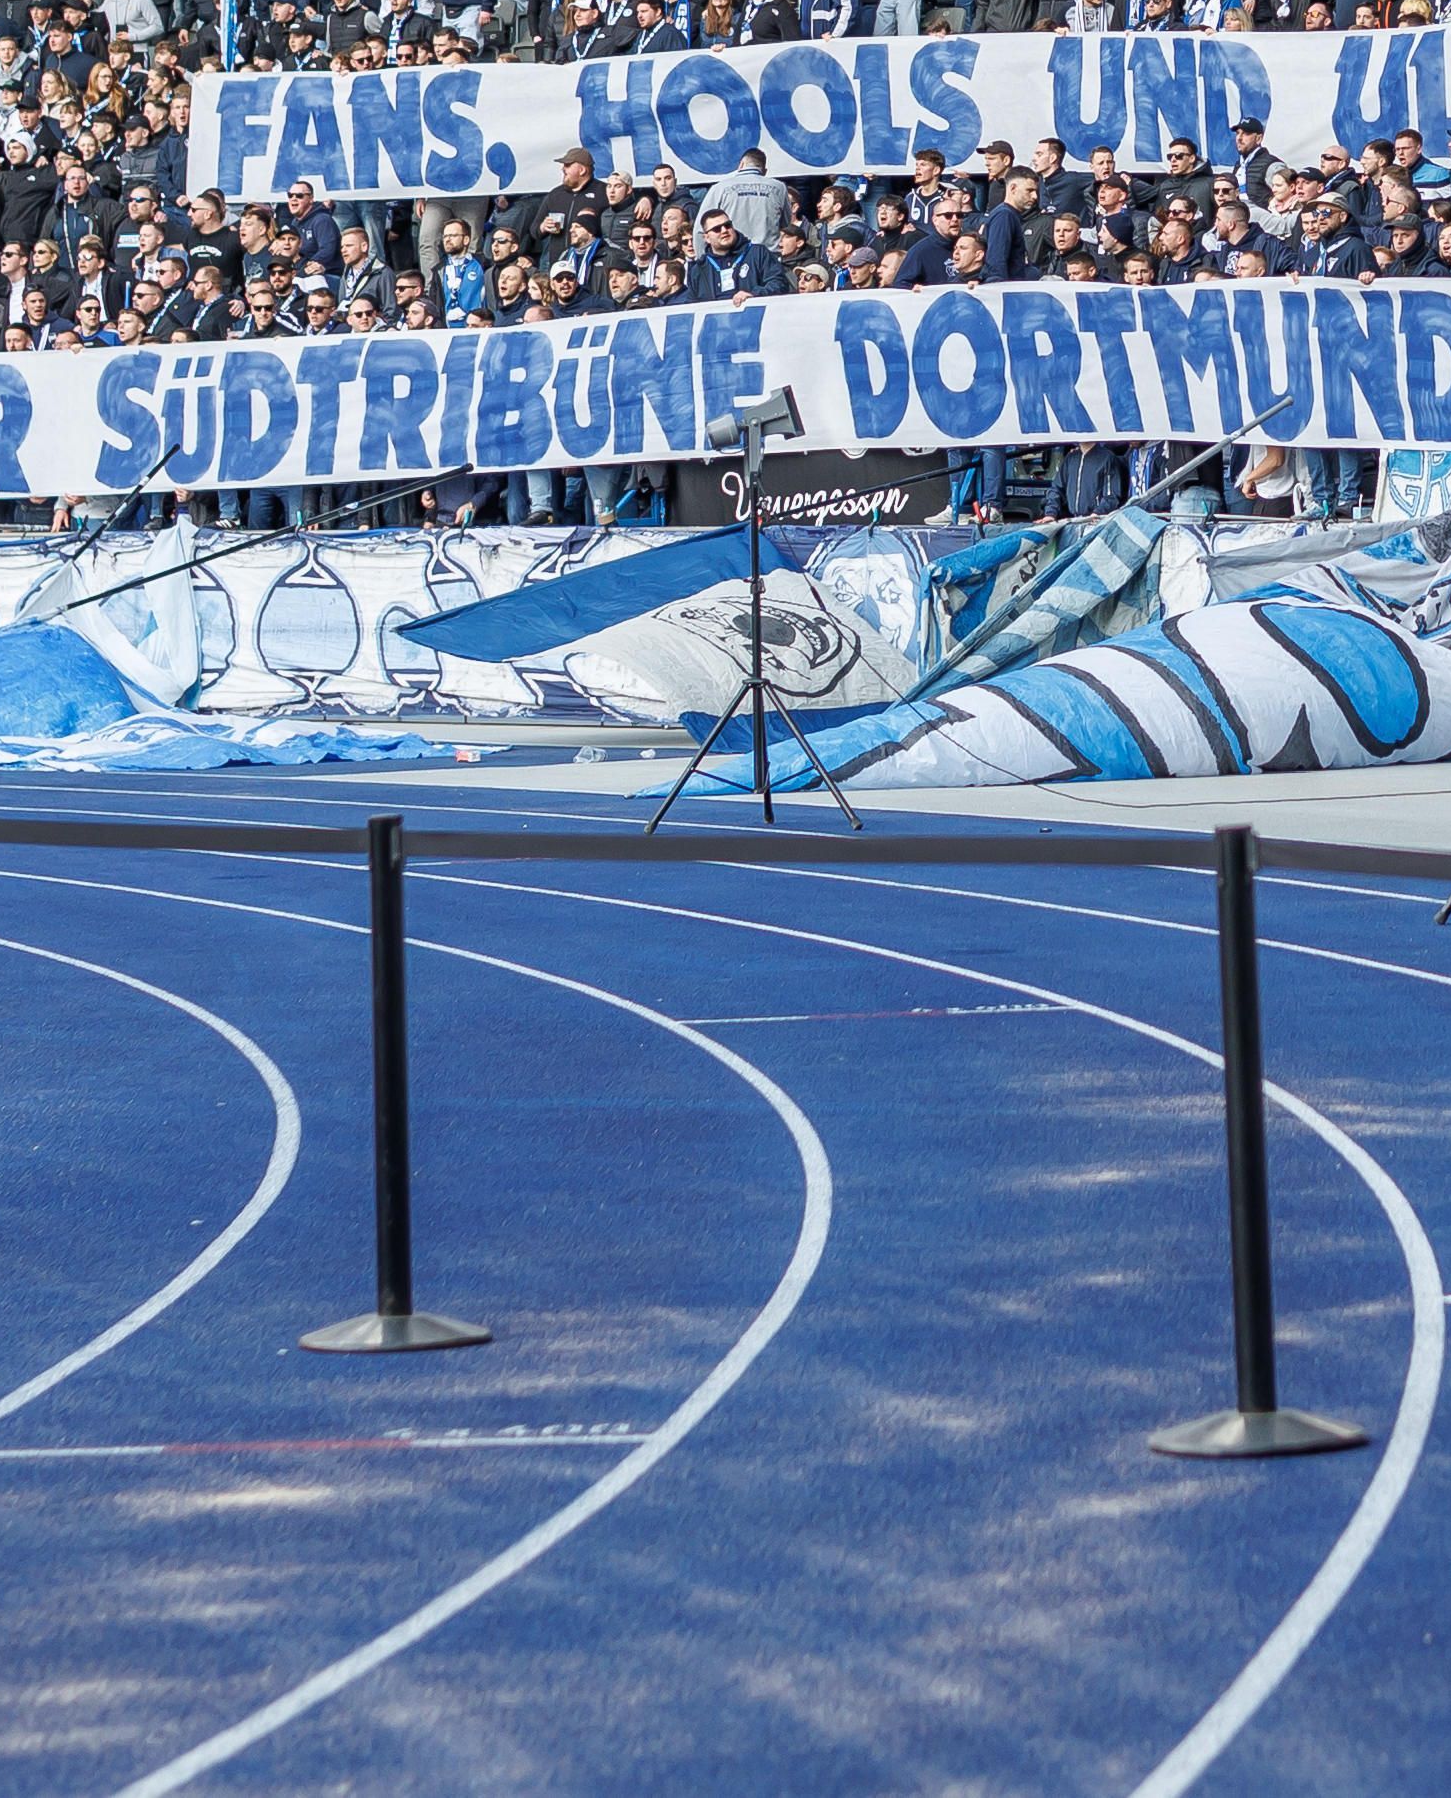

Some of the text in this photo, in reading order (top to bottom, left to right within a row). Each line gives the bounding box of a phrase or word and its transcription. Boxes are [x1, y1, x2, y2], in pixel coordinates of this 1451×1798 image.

[215, 68, 518, 198] FANS,
[573, 37, 982, 179] HOOLS
[1047, 35, 1275, 168] UND
[94, 304, 768, 490] SÜDTRIBÜNE
